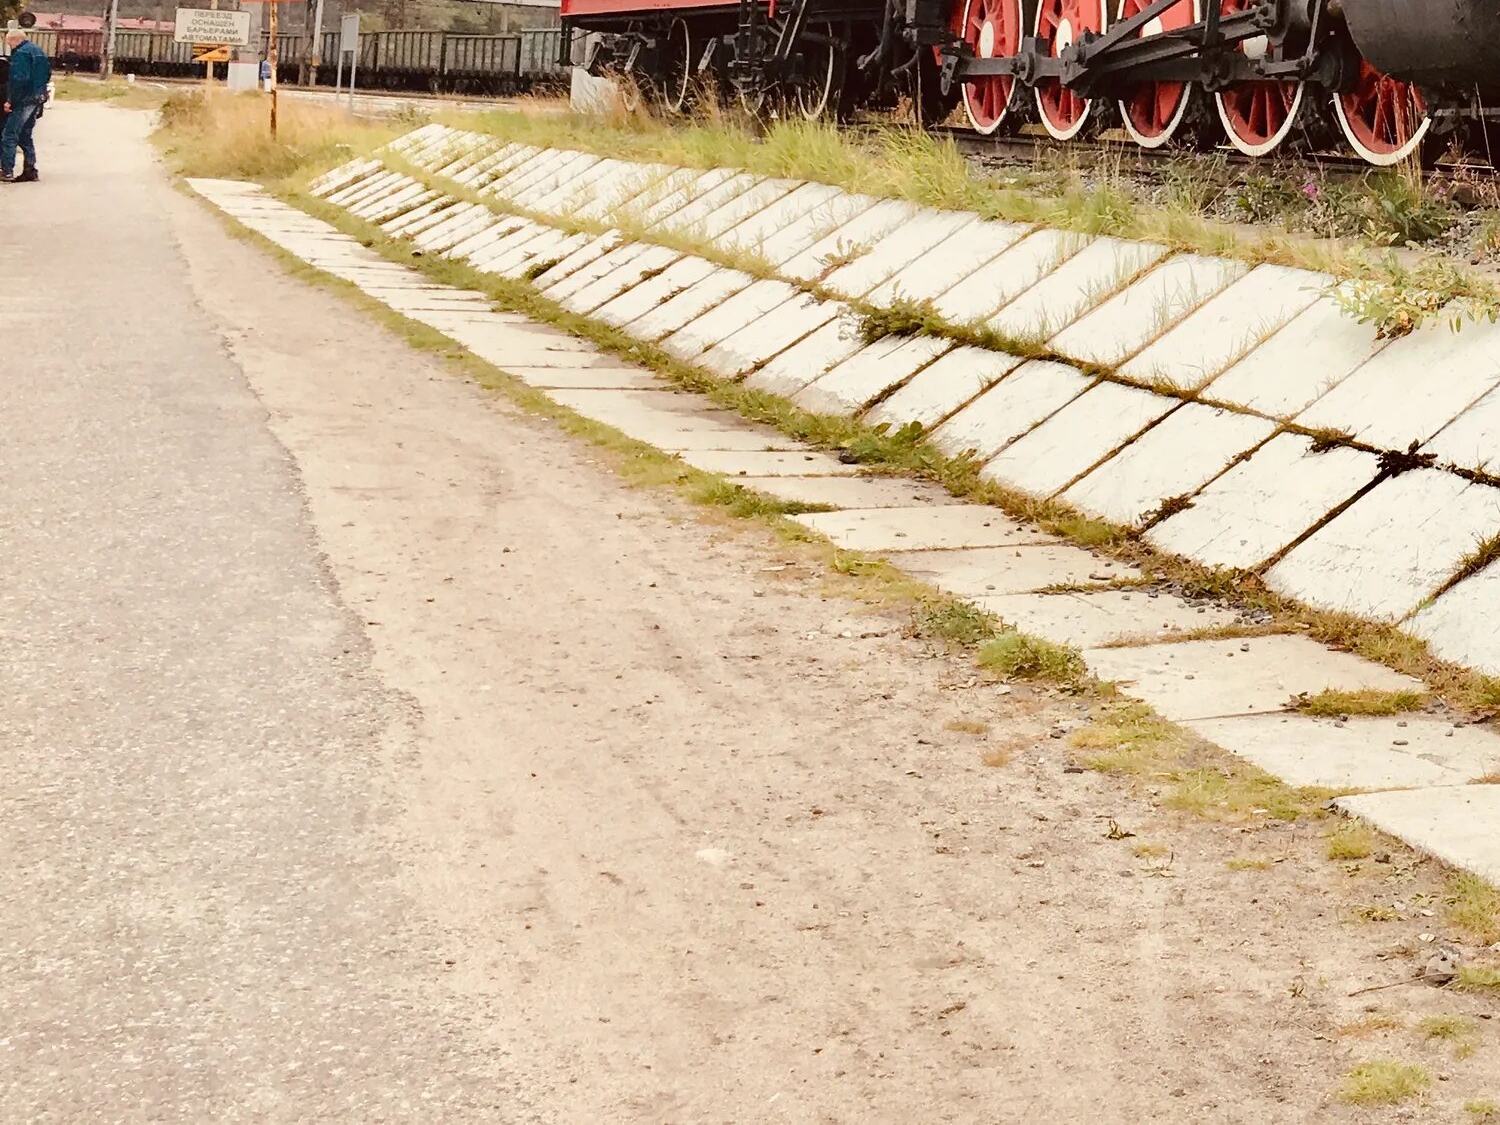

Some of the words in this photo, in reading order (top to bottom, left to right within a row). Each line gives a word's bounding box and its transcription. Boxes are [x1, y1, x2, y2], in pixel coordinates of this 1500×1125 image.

[194, 10, 233, 20] ПЕРЕЕЗД
[191, 18, 235, 27] ОСНАЩЕН
[186, 26, 239, 35] БАРЬЕРАМИ
